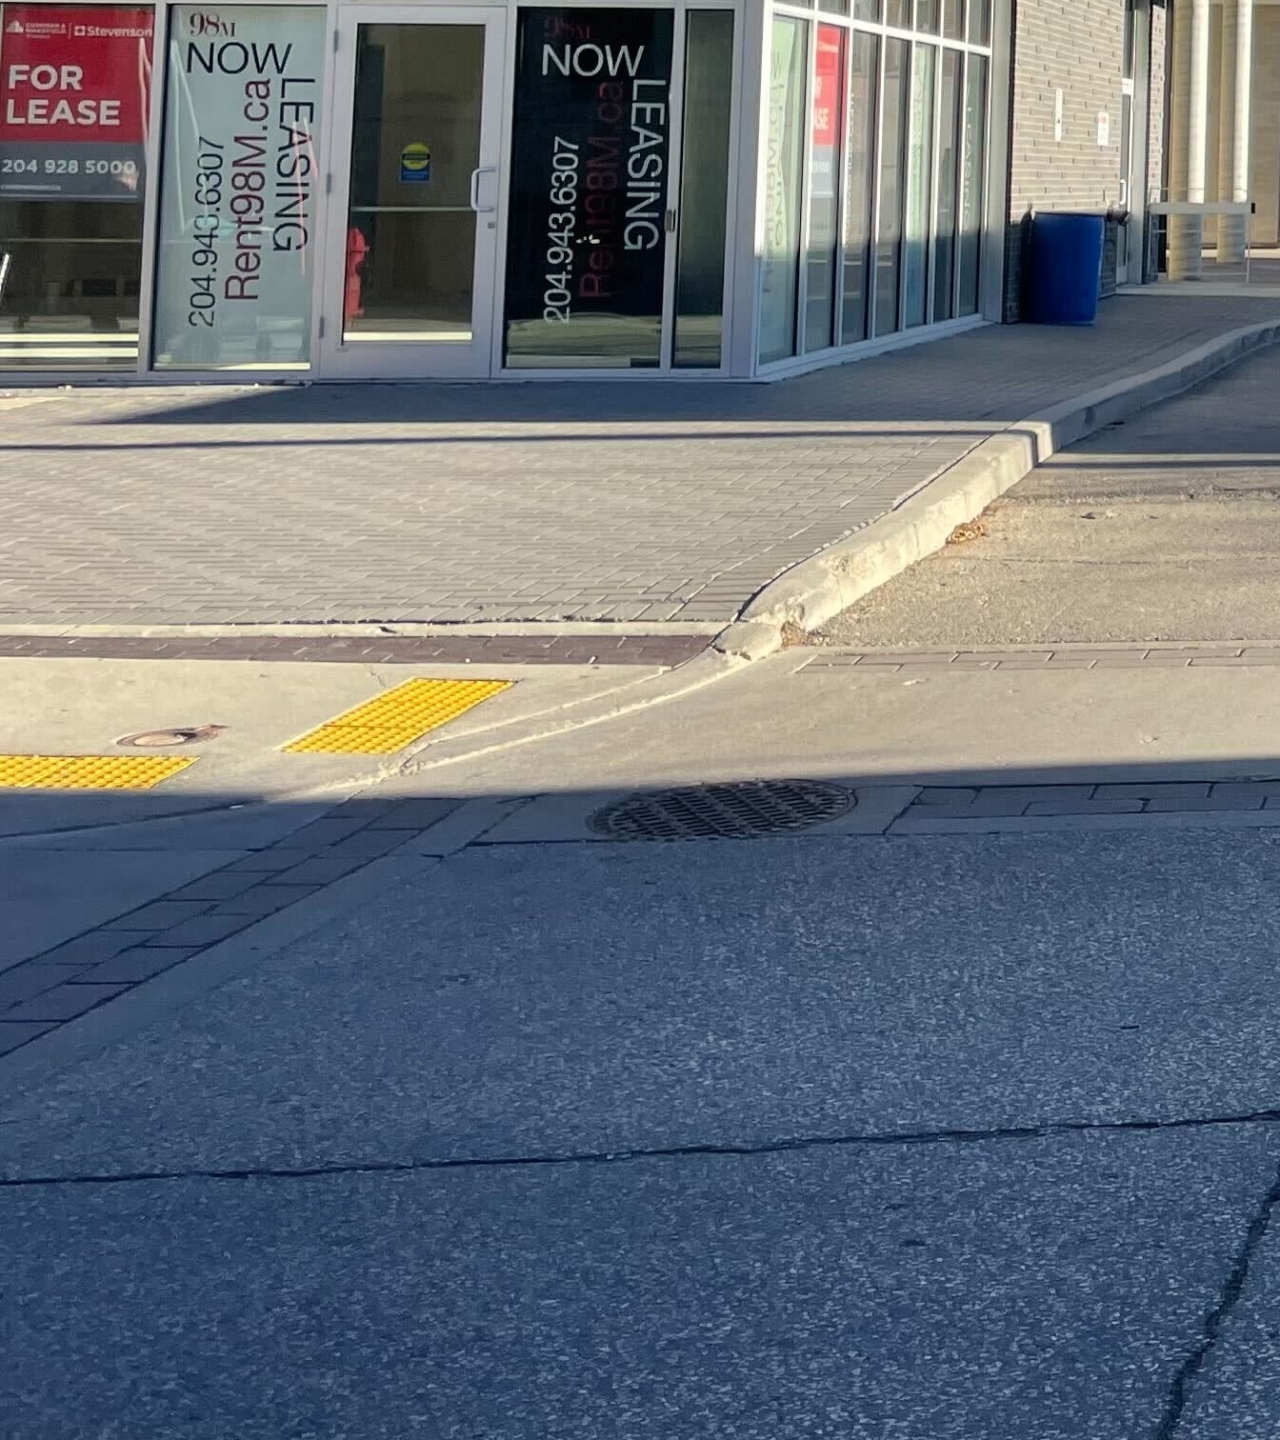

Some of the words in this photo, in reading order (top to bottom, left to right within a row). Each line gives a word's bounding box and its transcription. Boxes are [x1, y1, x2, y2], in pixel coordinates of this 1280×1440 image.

[86, 25, 153, 37] Stevenson
[189, 12, 236, 37] 98M
[186, 42, 293, 74] NOW
[542, 43, 646, 77] NOW
[8, 64, 84, 91] FOR
[6, 99, 121, 125] LEASE
[2, 159, 38, 174] 204
[44, 159, 79, 174] 928
[85, 160, 136, 174] 5000
[272, 78, 316, 251] LEASING
[623, 79, 667, 250] LEASING
[224, 78, 271, 300] Rent98M.ca
[188, 136, 224, 327] 204.943.6307
[543, 135, 580, 324] 204.943.6307
